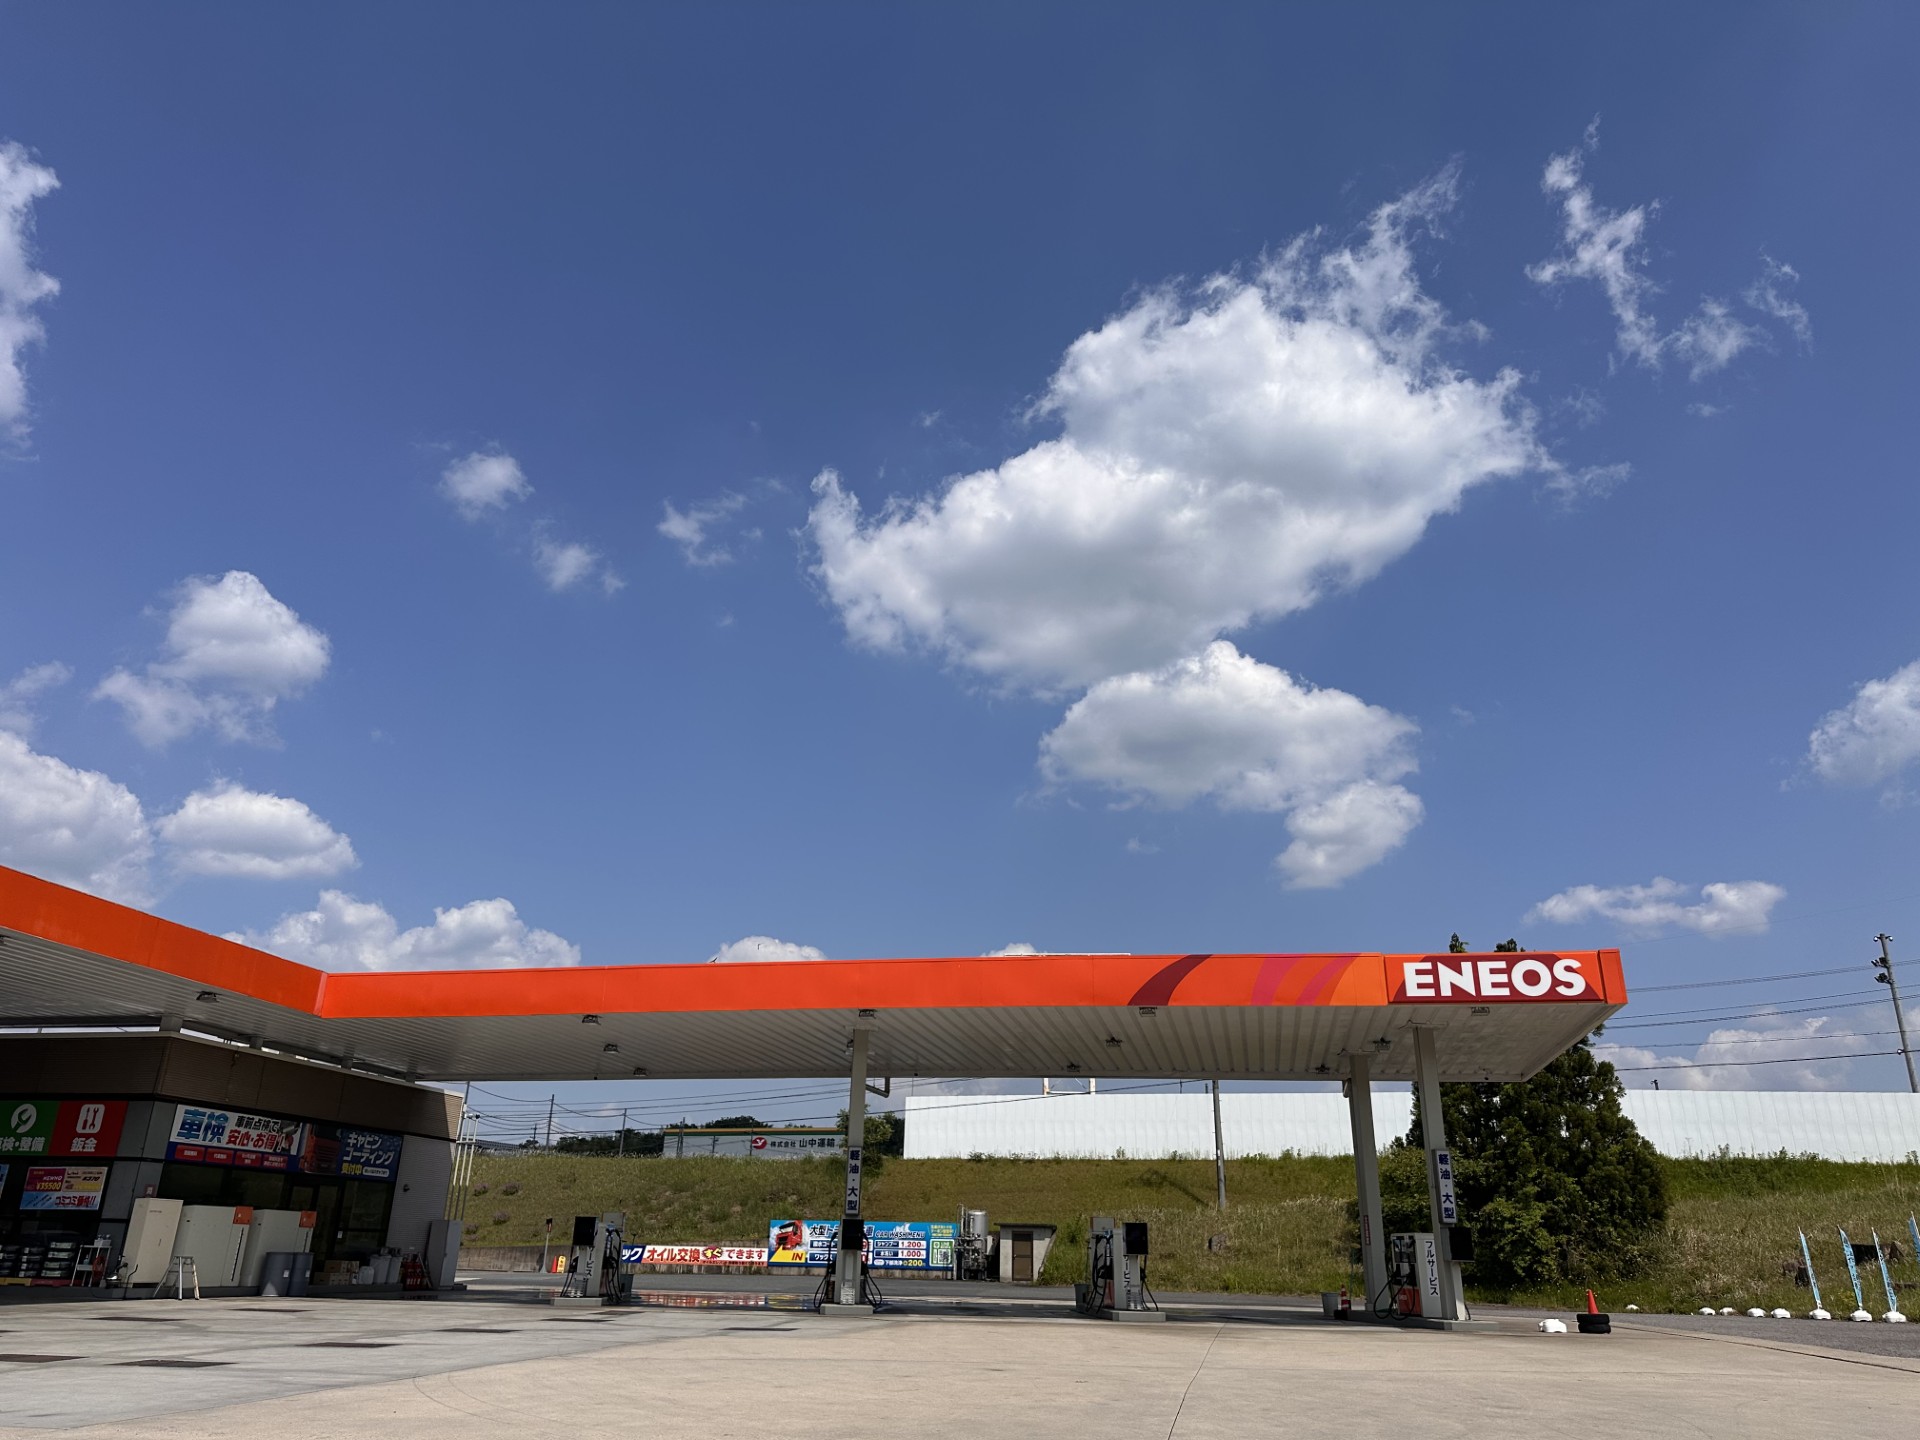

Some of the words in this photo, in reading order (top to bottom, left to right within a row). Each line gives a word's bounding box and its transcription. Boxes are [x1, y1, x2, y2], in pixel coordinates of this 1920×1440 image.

[1403, 958, 1588, 997] ENEOS
[176, 1108, 229, 1144] 車検
[347, 1131, 382, 1149] キャビン
[799, 1138, 835, 1148] 山中運輸
[343, 1147, 395, 1166] コーティング
[341, 1161, 364, 1176] 受付中
[889, 1230, 908, 1238] WASH
[908, 1230, 925, 1238] MENU
[792, 1252, 803, 1261] IN
[1425, 1240, 1439, 1296] フルサービス
